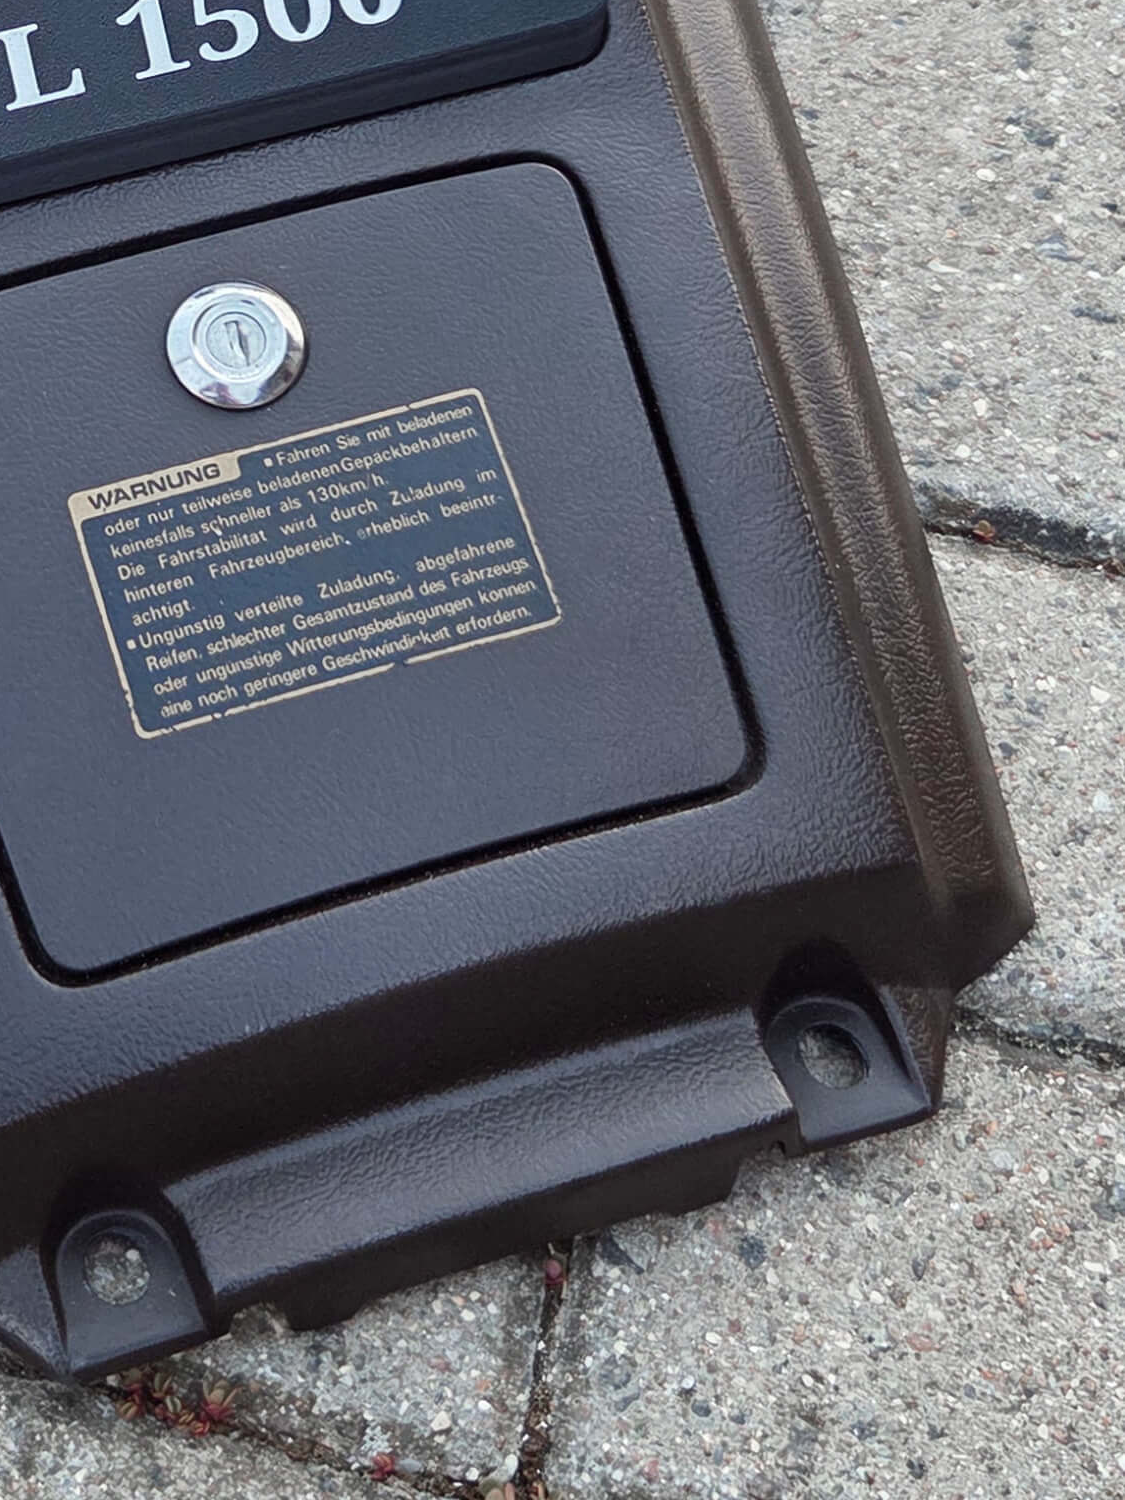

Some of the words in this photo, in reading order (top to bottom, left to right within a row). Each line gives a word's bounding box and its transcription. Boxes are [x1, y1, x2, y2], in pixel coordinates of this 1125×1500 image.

[274, 441, 331, 466] Fahren
[335, 431, 362, 451] Sie
[366, 425, 392, 443] mit
[396, 405, 473, 435] beladenen
[88, 463, 221, 510] WARNUNG
[104, 517, 141, 537] oder
[147, 507, 175, 525] nur
[181, 486, 253, 515] teilweise
[117, 562, 146, 581] Die
[279, 514, 318, 537] wird
[330, 498, 379, 524] durch
[389, 476, 467, 508] Zuladung
[476, 467, 497, 484] im
[110, 523, 196, 559] keinesfalls
[200, 505, 272, 535] schneller
[279, 496, 303, 514] als
[123, 573, 195, 605] hinteren
[356, 510, 431, 540] erheblich
[145, 647, 203, 673] Reifen,
[206, 622, 286, 656] schlechter
[291, 583, 415, 631] Gesamtzustand
[418, 578, 448, 596] des
[451, 556, 530, 588] Fahrzeugs
[234, 593, 305, 623] verteilte
[415, 535, 517, 573] abgefahrene
[153, 674, 189, 696] oder
[285, 595, 475, 658] Witterungsbedingungen
[160, 698, 194, 719] eine
[197, 683, 239, 708] noch
[243, 663, 319, 698] geringere
